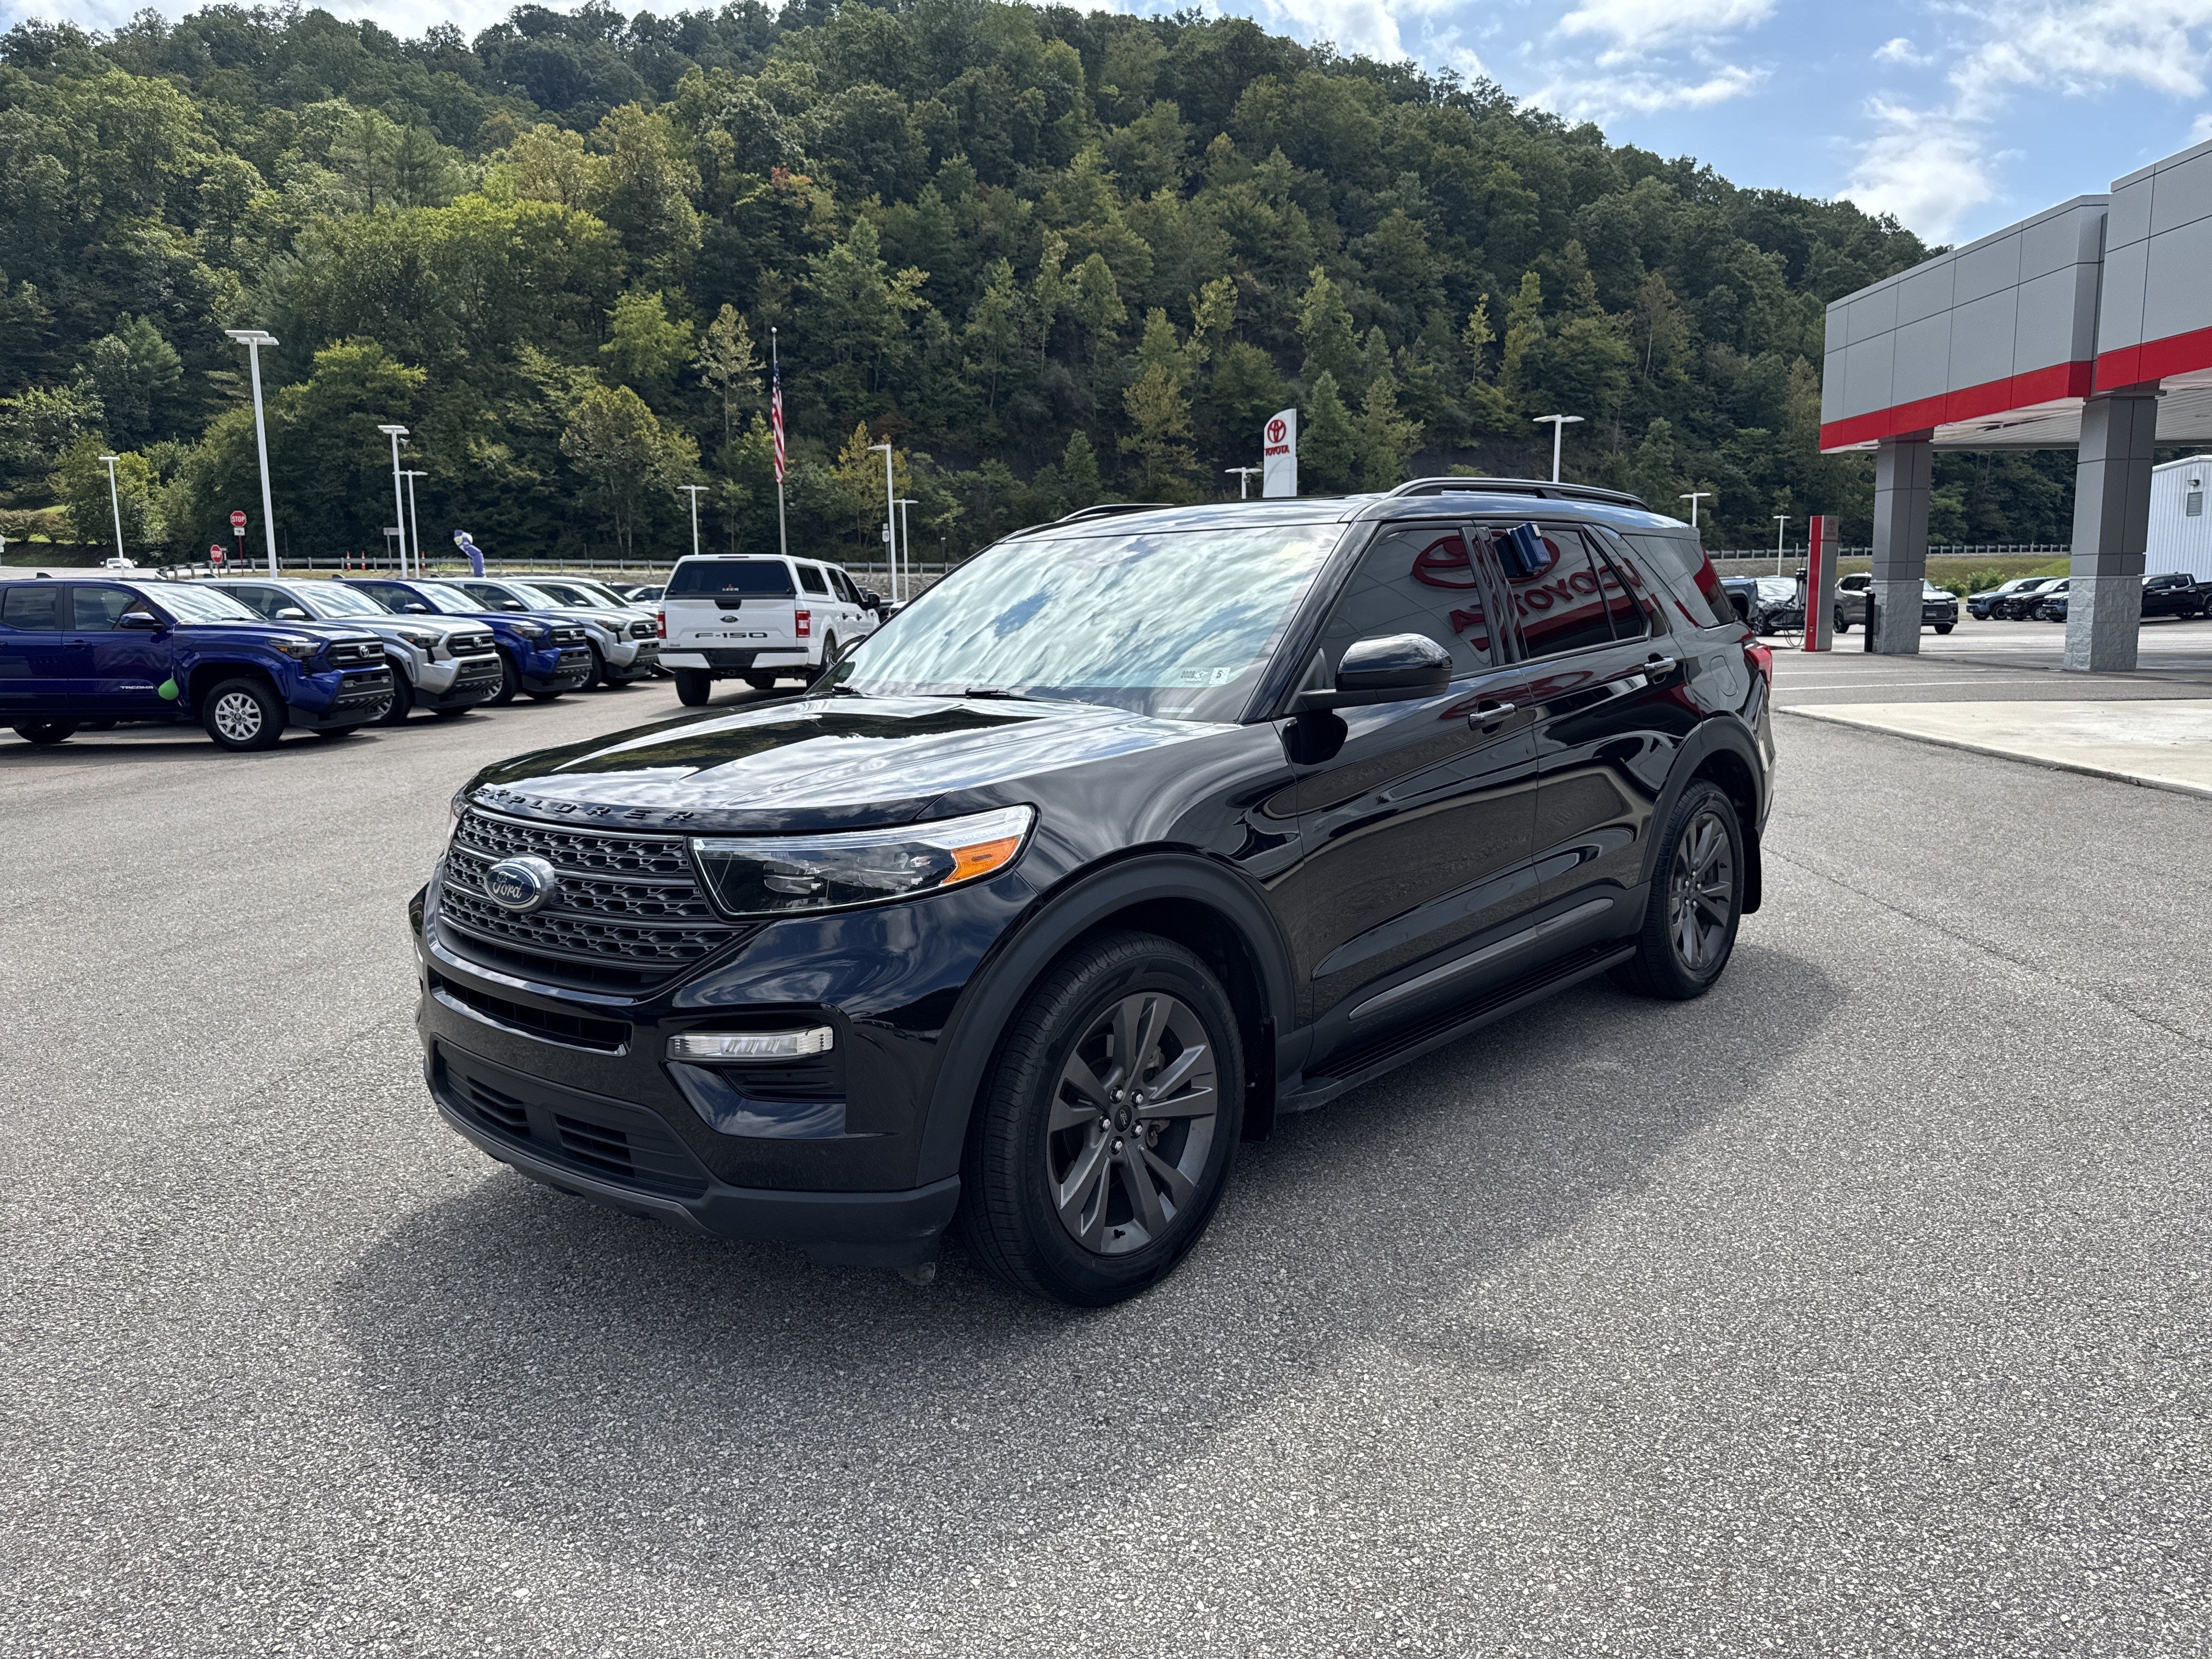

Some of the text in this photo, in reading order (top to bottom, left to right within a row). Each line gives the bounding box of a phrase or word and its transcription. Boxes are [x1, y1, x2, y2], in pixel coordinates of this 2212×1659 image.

[1265, 445, 1290, 456] TOYOTA
[1216, 670, 1223, 679] 5
[474, 787, 694, 821] EXPLORER
[949, 826, 1014, 845] EXPLORER
[493, 871, 524, 899] Ford
